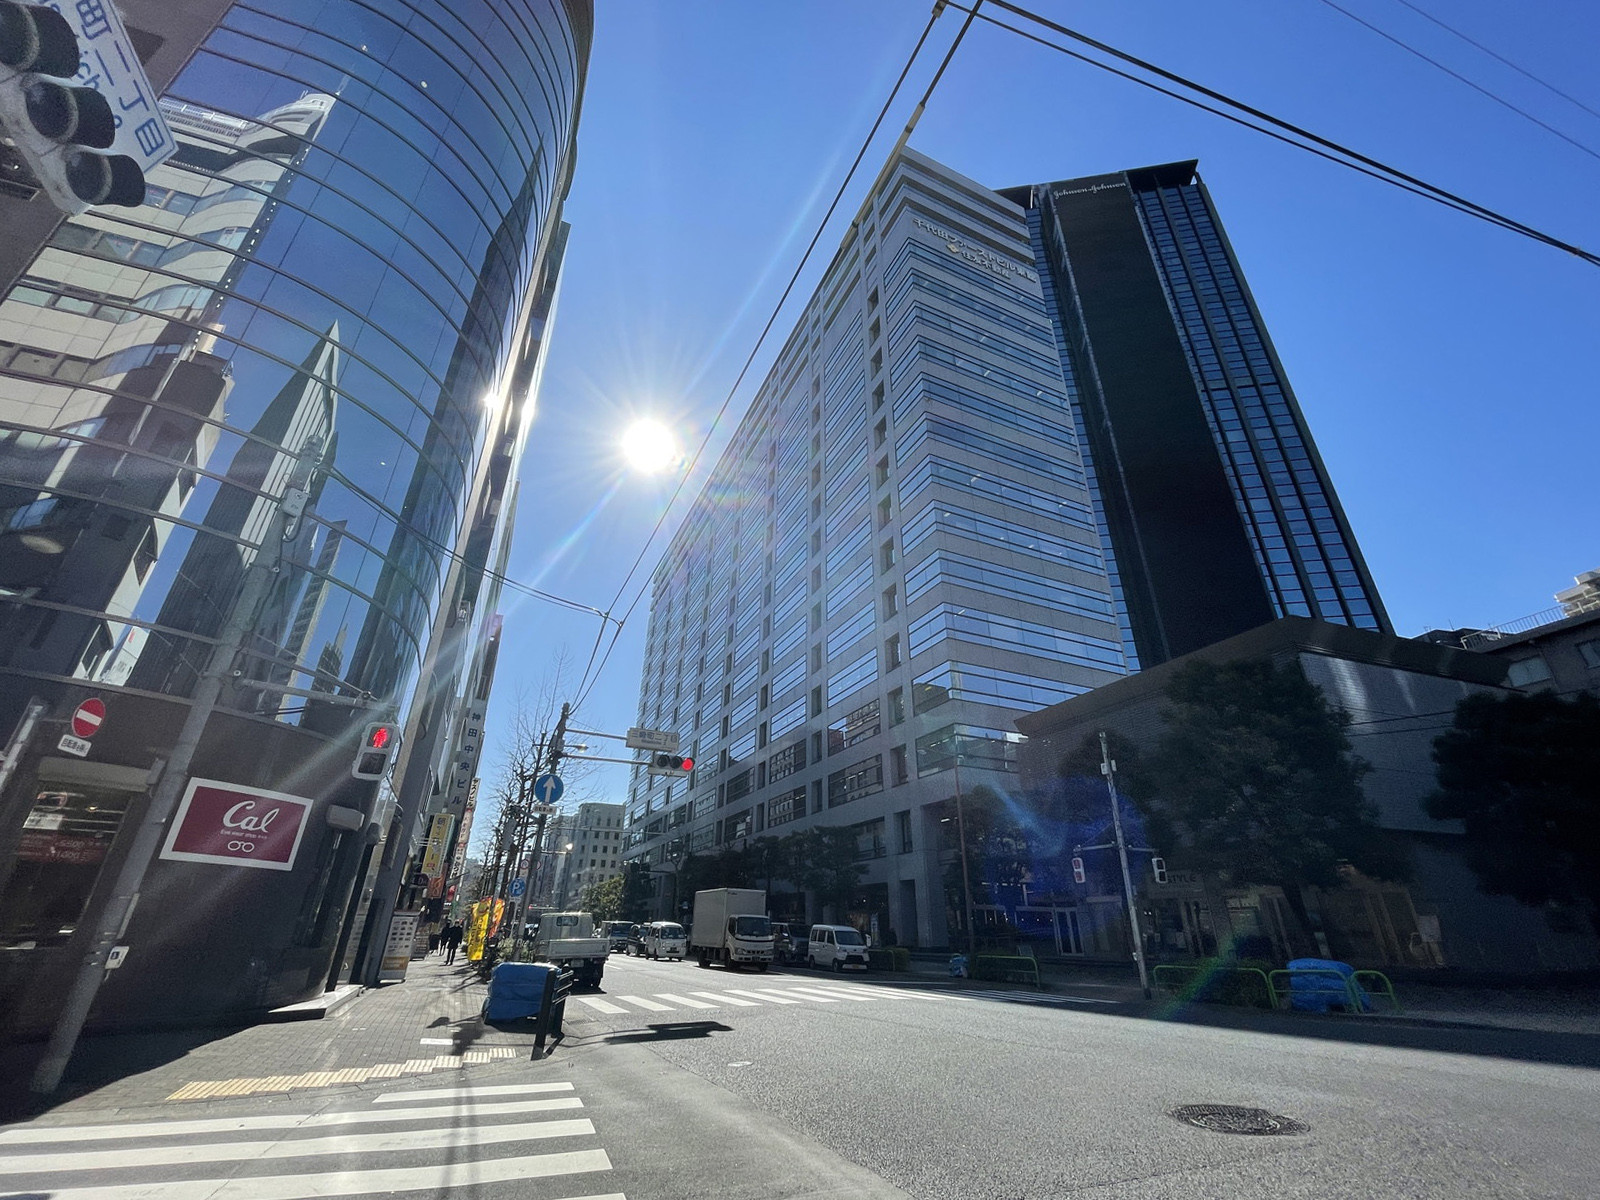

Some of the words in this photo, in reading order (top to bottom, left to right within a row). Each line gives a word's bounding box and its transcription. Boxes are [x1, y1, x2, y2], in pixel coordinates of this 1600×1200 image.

[452, 712, 481, 805] 神田中央ビル
[223, 800, 280, 833] Cal
